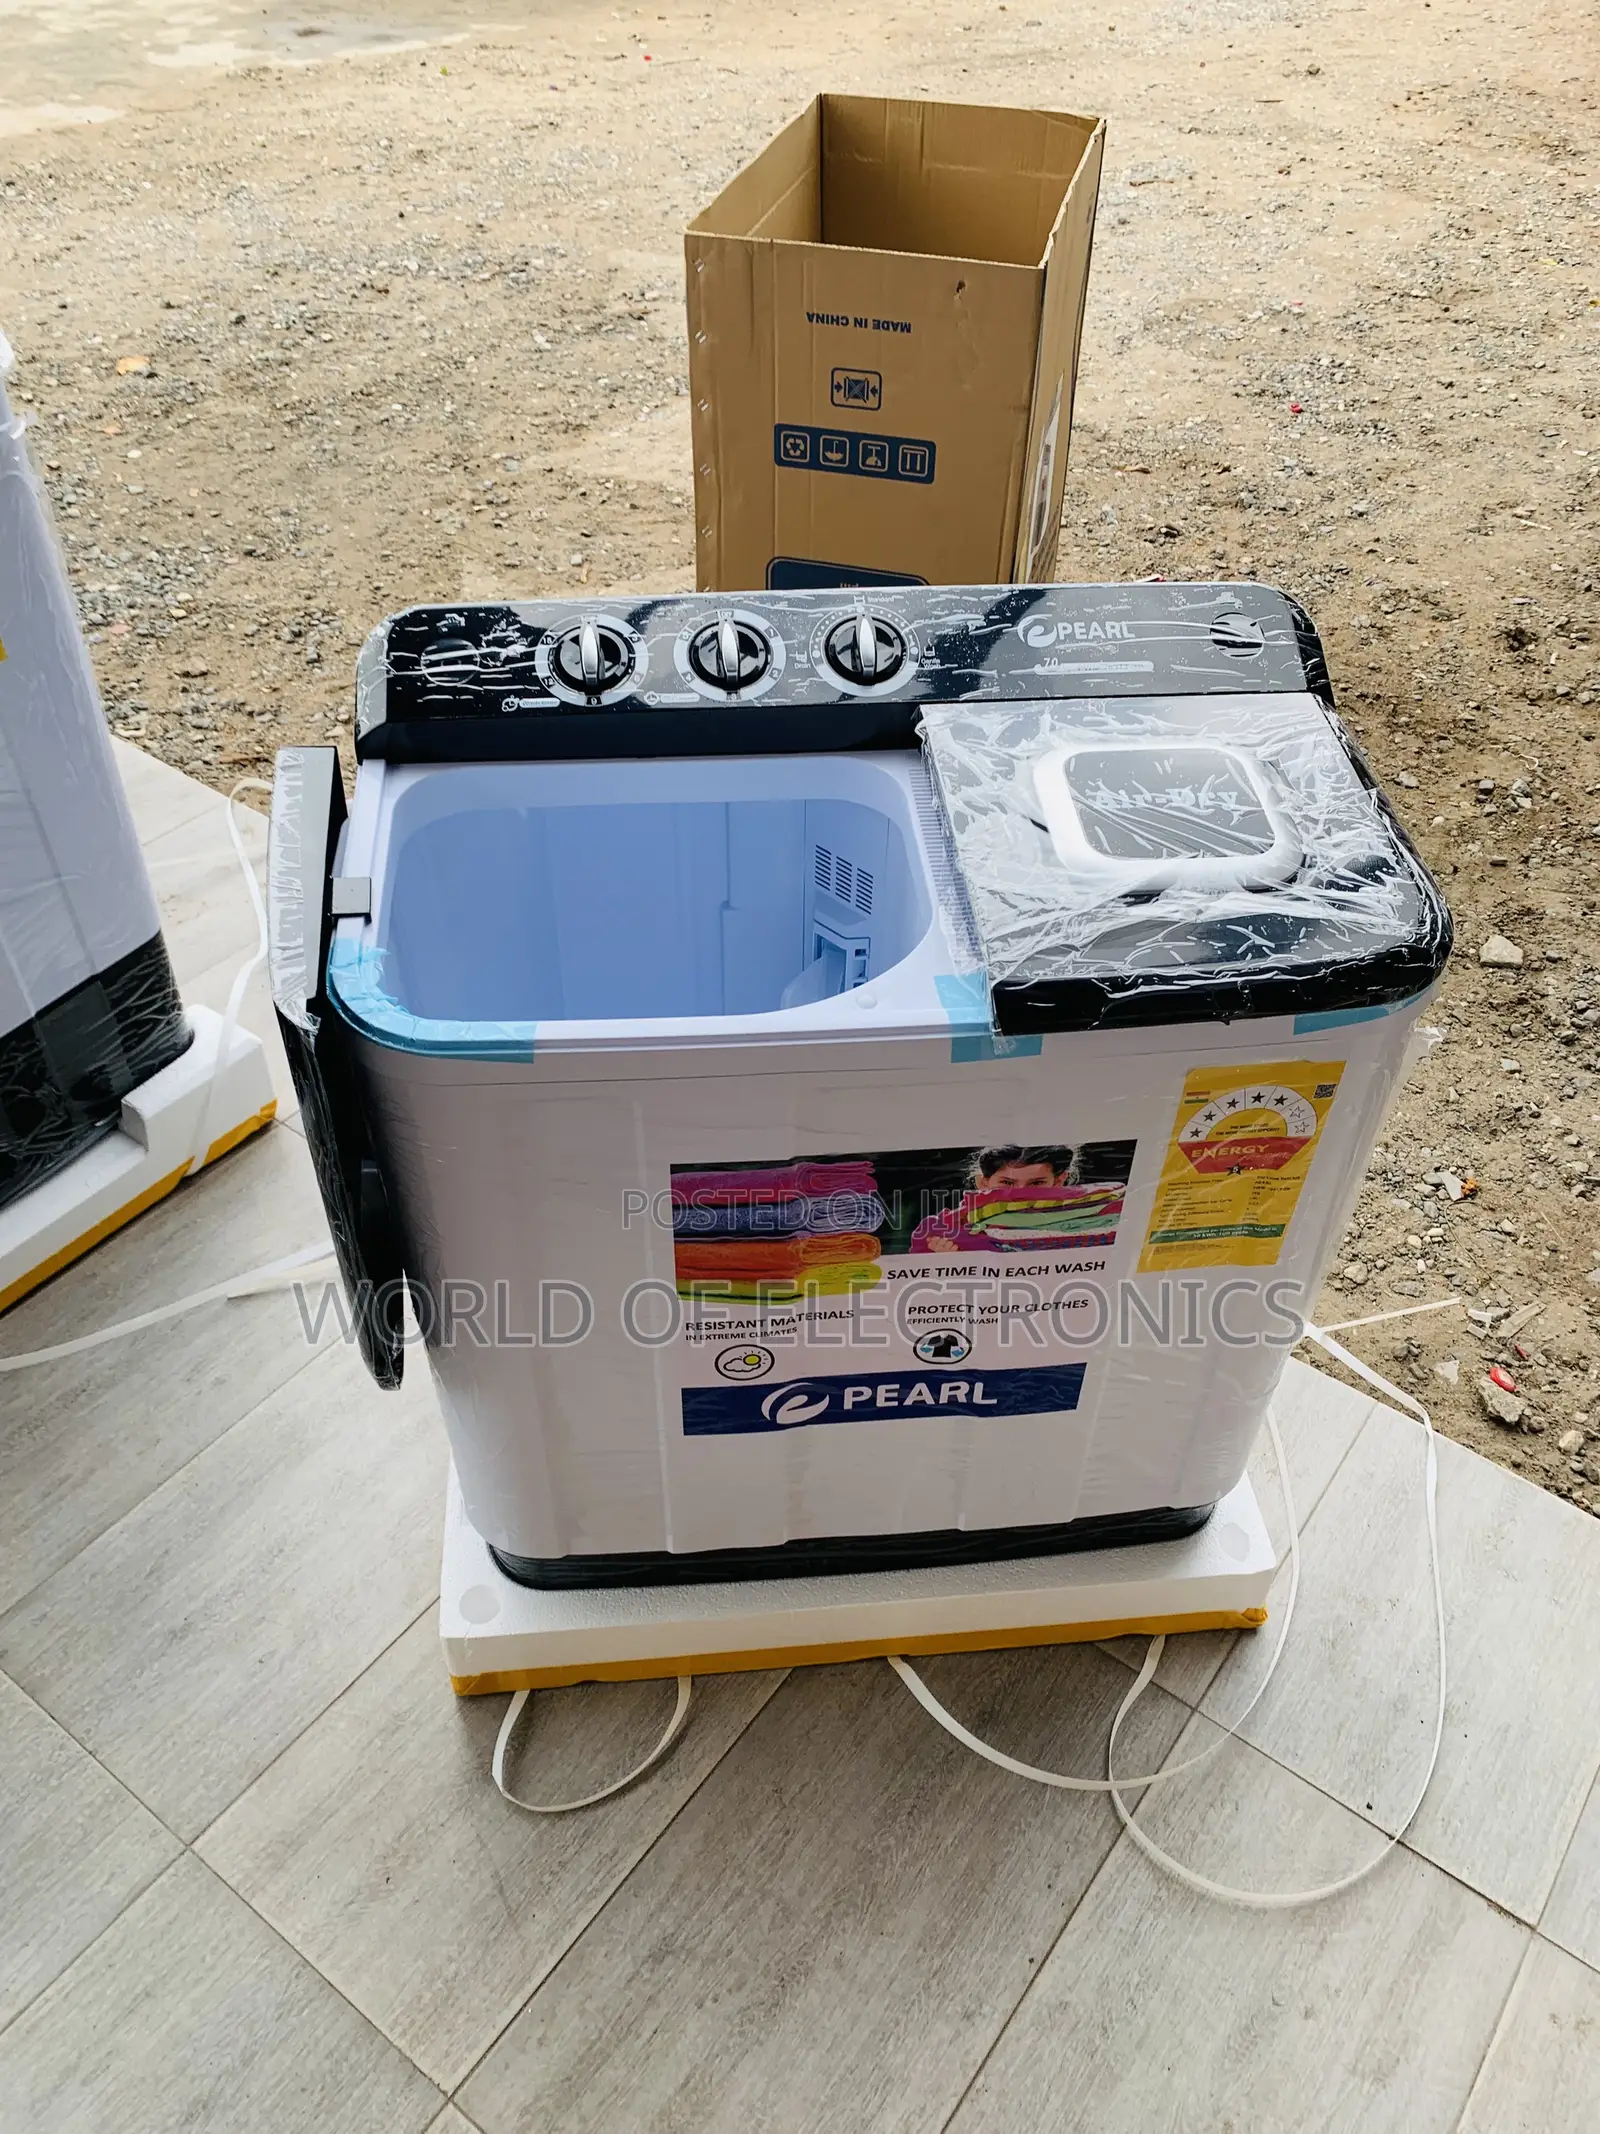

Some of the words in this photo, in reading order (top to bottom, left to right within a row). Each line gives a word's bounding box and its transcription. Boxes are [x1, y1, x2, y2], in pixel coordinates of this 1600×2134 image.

[805, 311, 850, 327] CHINA
[853, 316, 869, 329] IN
[872, 318, 912, 334] MADE
[1057, 620, 1136, 641] PEARL
[1191, 1143, 1270, 1159] ENERGY
[887, 1267, 931, 1280] SAVE
[935, 1265, 978, 1278] TIME
[982, 1266, 1001, 1279] IN
[1005, 1265, 1050, 1278] EACH
[1054, 1260, 1106, 1275] WASH
[907, 1303, 975, 1315] PROTECT
[978, 1303, 1021, 1315] YOUR
[1024, 1299, 1090, 1313] CLOTHES
[685, 1319, 767, 1332] RESISTANT
[770, 1309, 856, 1327] MATERIALS
[906, 1316, 967, 1326] EFFICIENTLY
[968, 1317, 999, 1326] WASH
[699, 1332, 747, 1341] EXTREME
[748, 1326, 799, 1339] CLIMATES
[843, 1381, 999, 1411] PEARL
